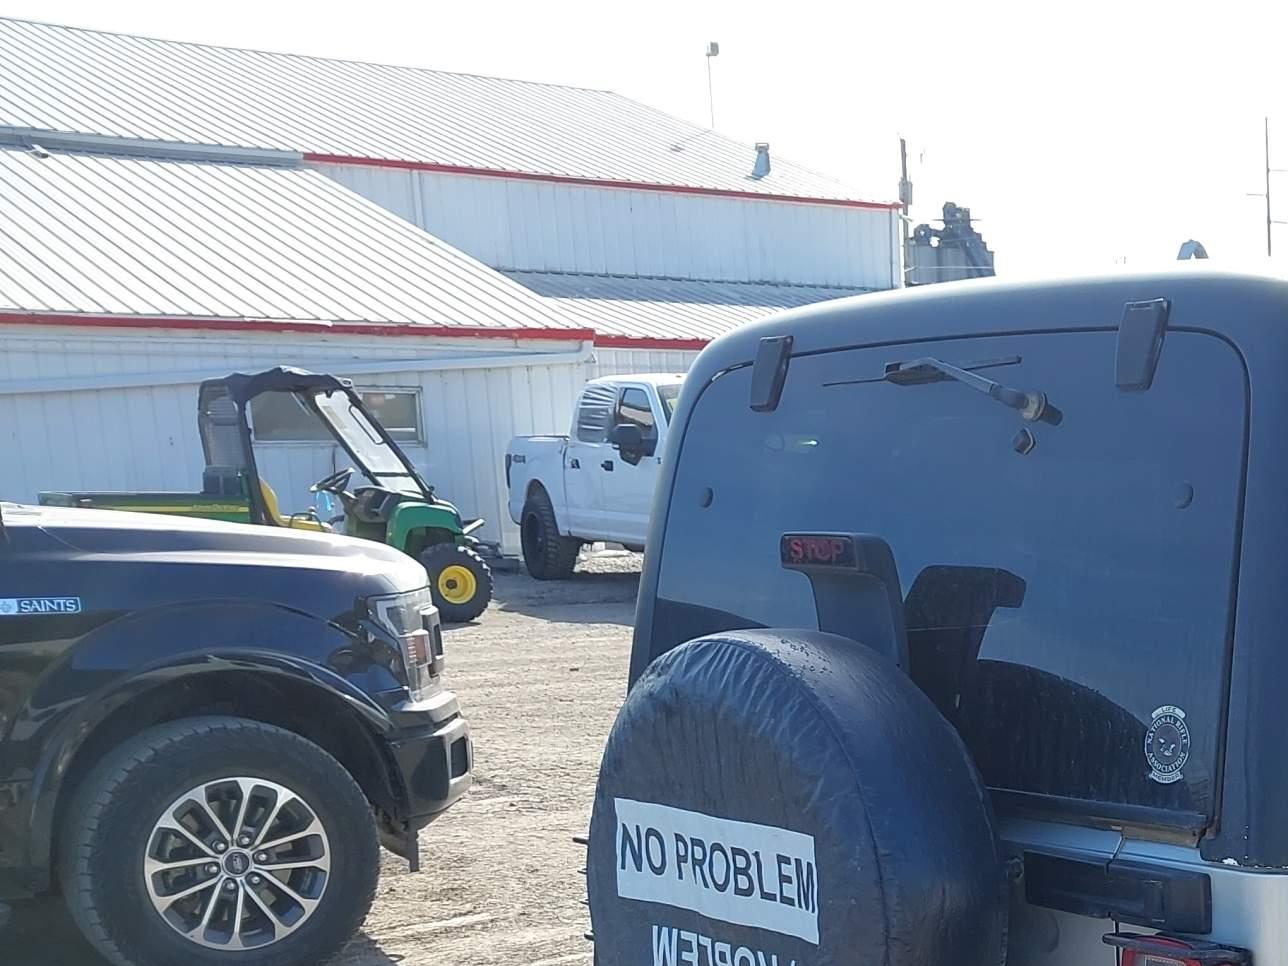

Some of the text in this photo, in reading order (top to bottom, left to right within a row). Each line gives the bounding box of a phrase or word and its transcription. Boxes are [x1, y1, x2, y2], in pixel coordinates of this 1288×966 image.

[790, 539, 845, 562] STOP
[20, 599, 76, 612] SAINTS
[1147, 716, 1187, 744] NATIONAL RIFLE
[1148, 752, 1185, 772] ASSOCIATION
[620, 822, 816, 914] NO PROBLEM
